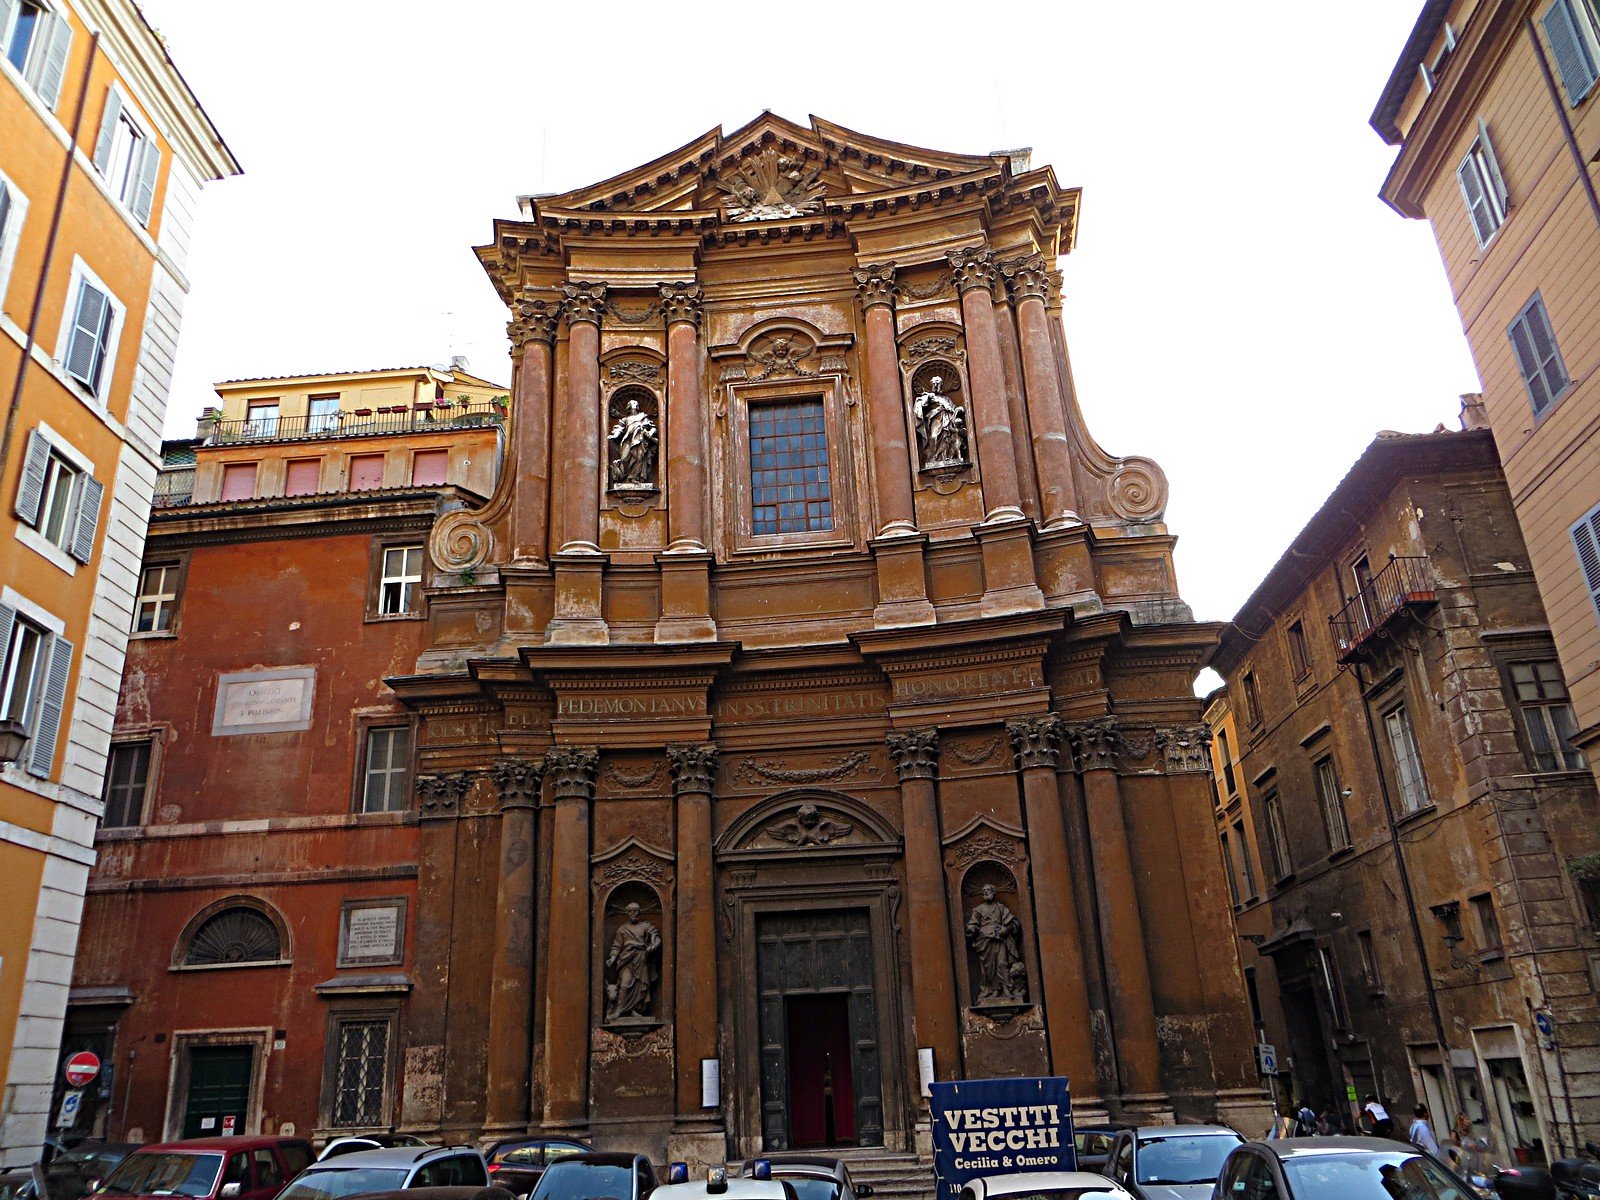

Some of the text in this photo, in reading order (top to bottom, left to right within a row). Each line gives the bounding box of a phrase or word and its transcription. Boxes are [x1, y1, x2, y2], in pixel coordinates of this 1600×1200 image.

[557, 696, 707, 714] PEDEMONTANVS
[718, 701, 740, 717] IN
[944, 1104, 1060, 1130] VESTITI
[949, 1127, 1060, 1153] VECCHI
[954, 1154, 1058, 1170] Cecilia & Omero
